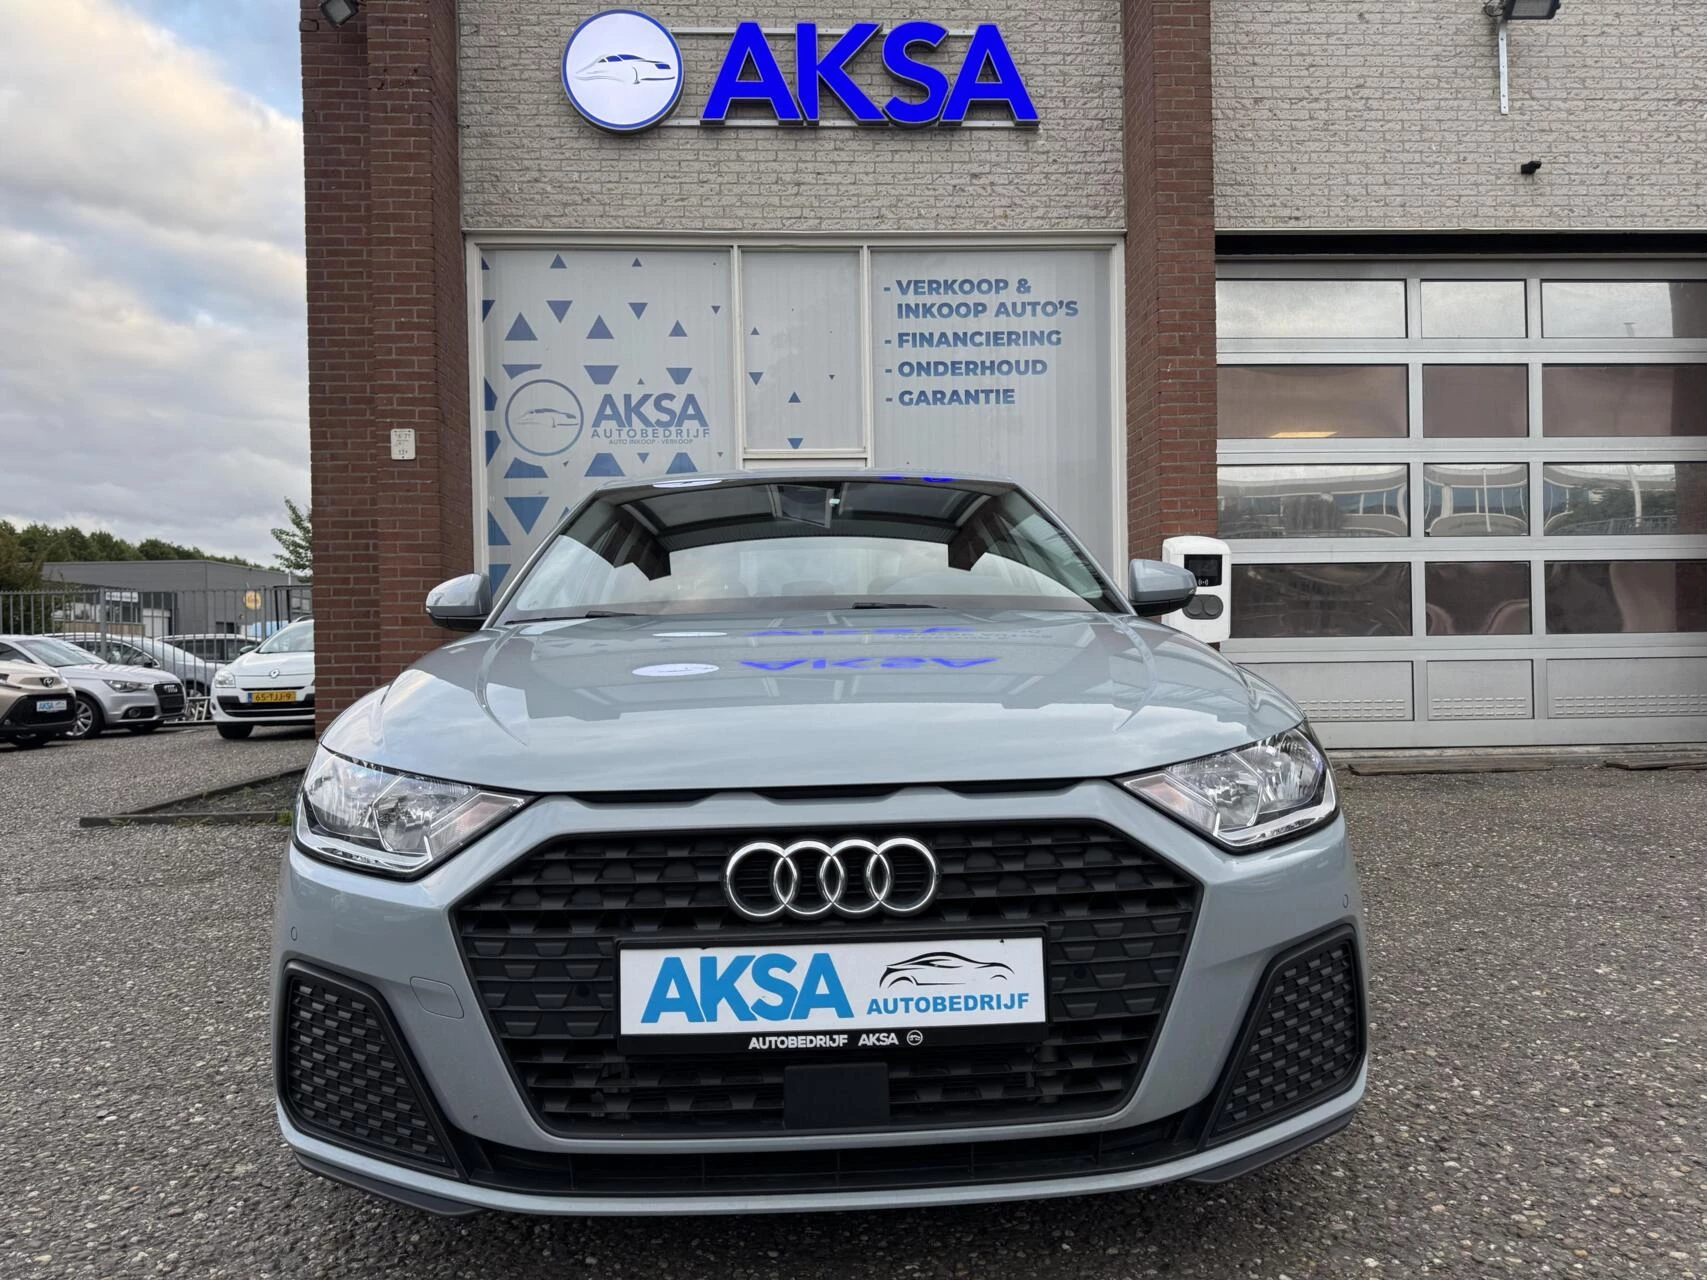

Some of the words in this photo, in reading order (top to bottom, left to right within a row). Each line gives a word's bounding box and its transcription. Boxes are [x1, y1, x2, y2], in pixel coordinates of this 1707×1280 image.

[703, 22, 1038, 125] AKSA
[896, 279, 1009, 296] VERKOOP
[1016, 278, 1032, 294] &
[897, 302, 988, 319] INKOOP
[994, 300, 1079, 318] AUTO'S
[898, 330, 1062, 348] FINANCIERING
[898, 359, 1048, 377] ONDERHOUD
[898, 389, 1016, 406] GARANTIE
[592, 393, 710, 428] AKSA
[591, 428, 711, 438] AUTOBEDRIJF
[641, 952, 855, 1024] AKSA
[867, 992, 1030, 1016] AUTOBEDRIJF
[748, 1033, 850, 1051] AUTOBEDRIJF
[857, 1032, 899, 1047] AKSA
